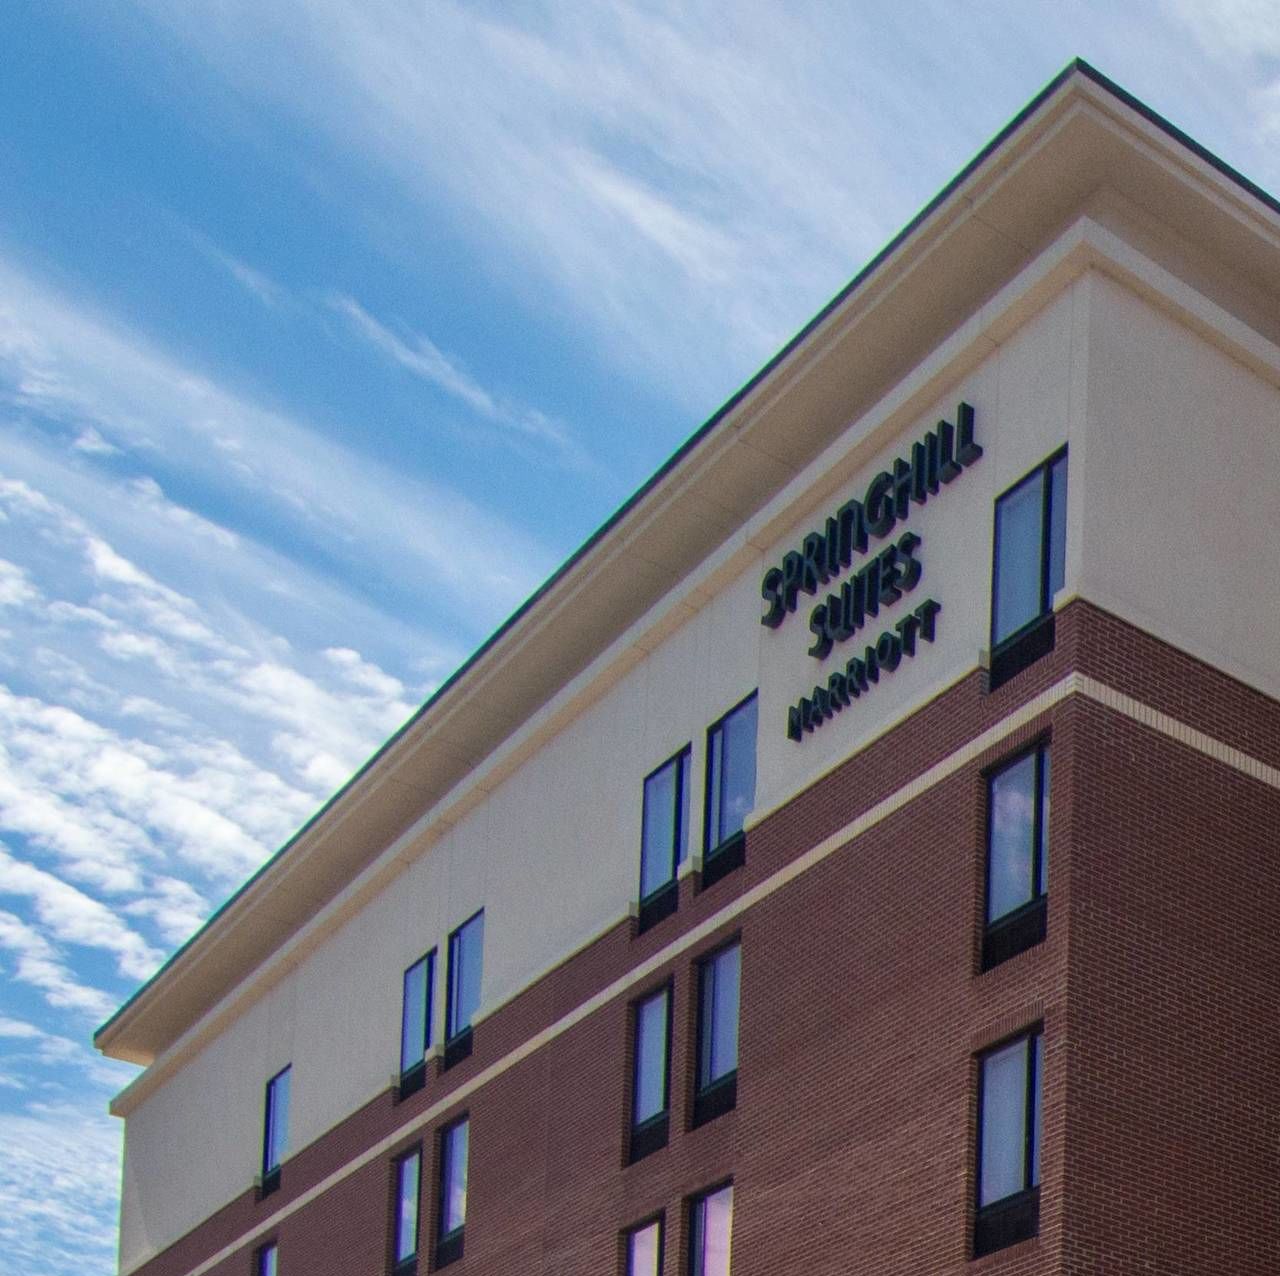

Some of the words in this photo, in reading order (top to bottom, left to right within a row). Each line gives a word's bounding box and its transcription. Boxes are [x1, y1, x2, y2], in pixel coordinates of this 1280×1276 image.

[761, 401, 984, 630] SPRINGHILL
[808, 531, 922, 661] SUITES
[787, 598, 942, 743] MARRIOTT
